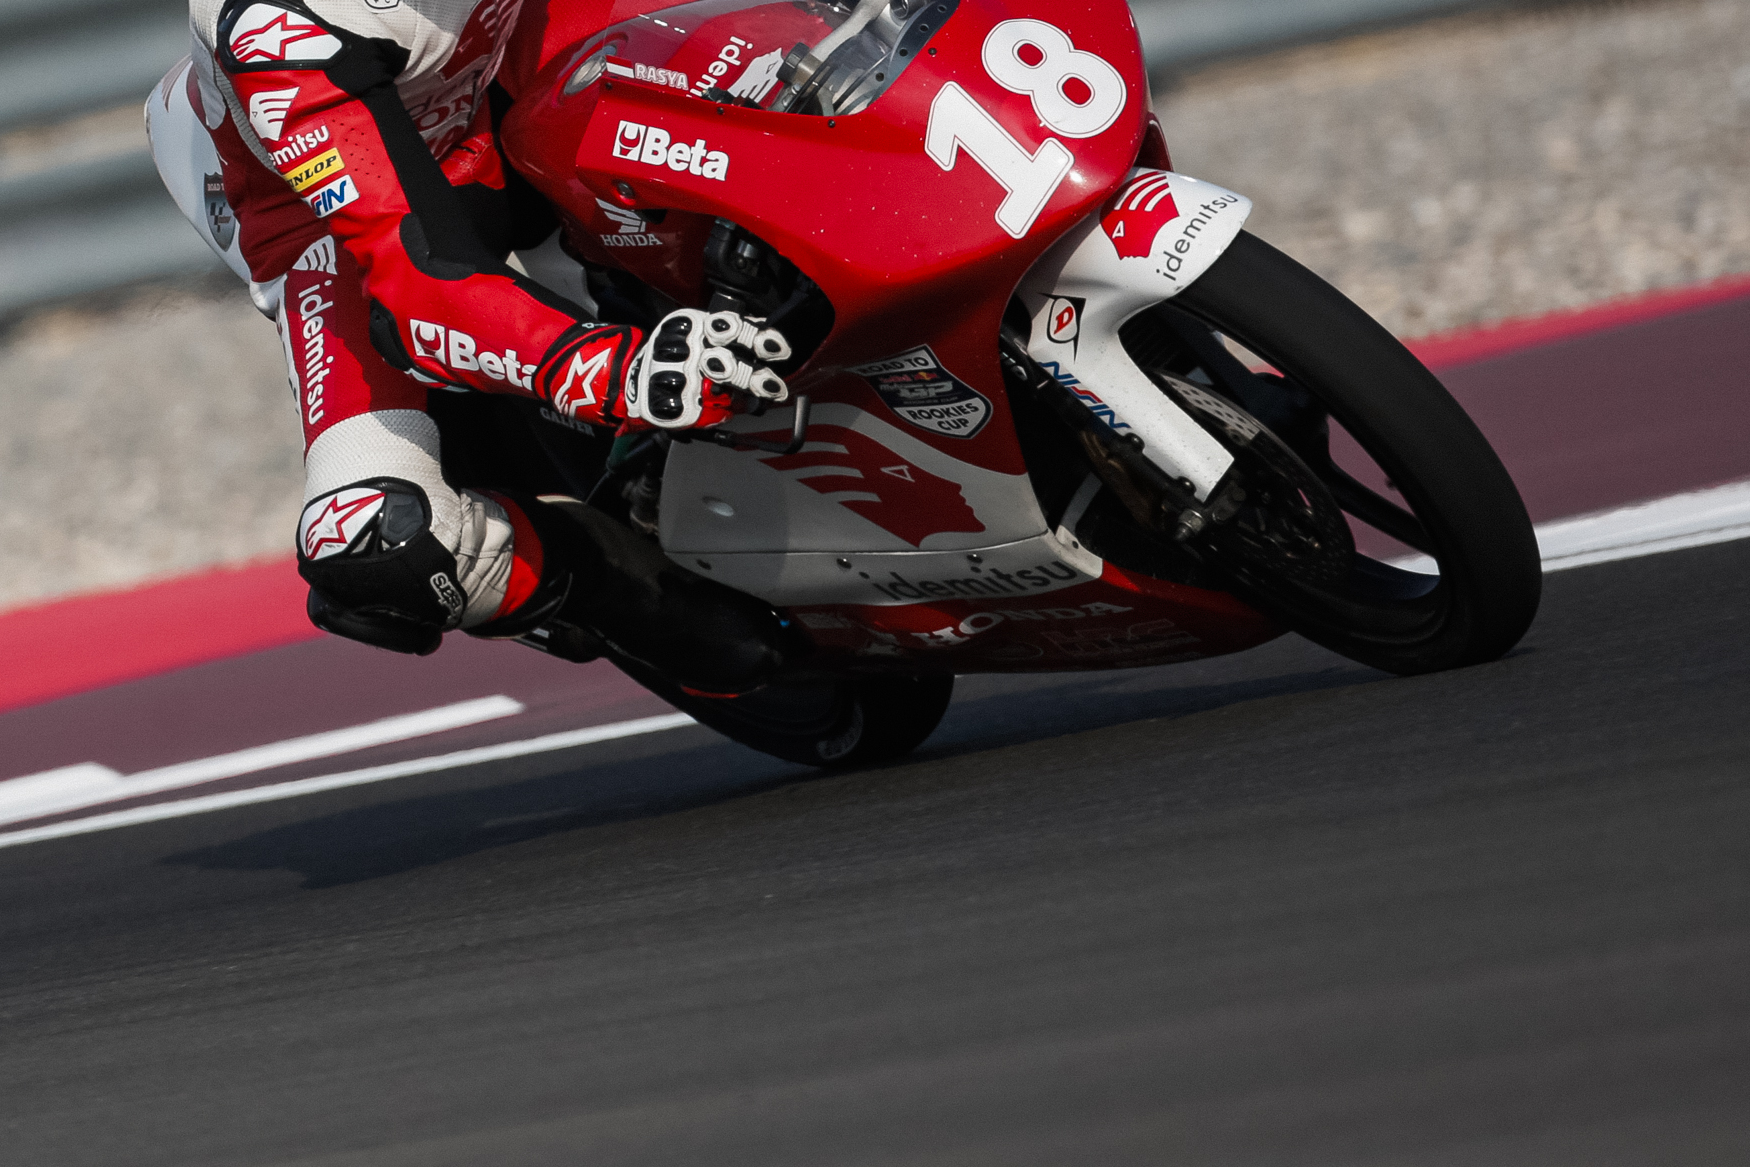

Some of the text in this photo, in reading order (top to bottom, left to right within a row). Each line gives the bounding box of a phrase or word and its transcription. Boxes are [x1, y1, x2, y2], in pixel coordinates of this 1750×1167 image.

[634, 62, 689, 91] RASYA
[925, 18, 1128, 239] 18
[640, 126, 730, 182] Beta
[600, 233, 663, 247] HONDA
[1156, 194, 1239, 281] idemitsu
[298, 279, 334, 425] idemitsu
[905, 356, 930, 368] TO
[906, 402, 979, 421] ROOKIES
[937, 418, 969, 431] CUP
[858, 557, 1077, 601] idemitsu
[910, 601, 1134, 647] HONDA
